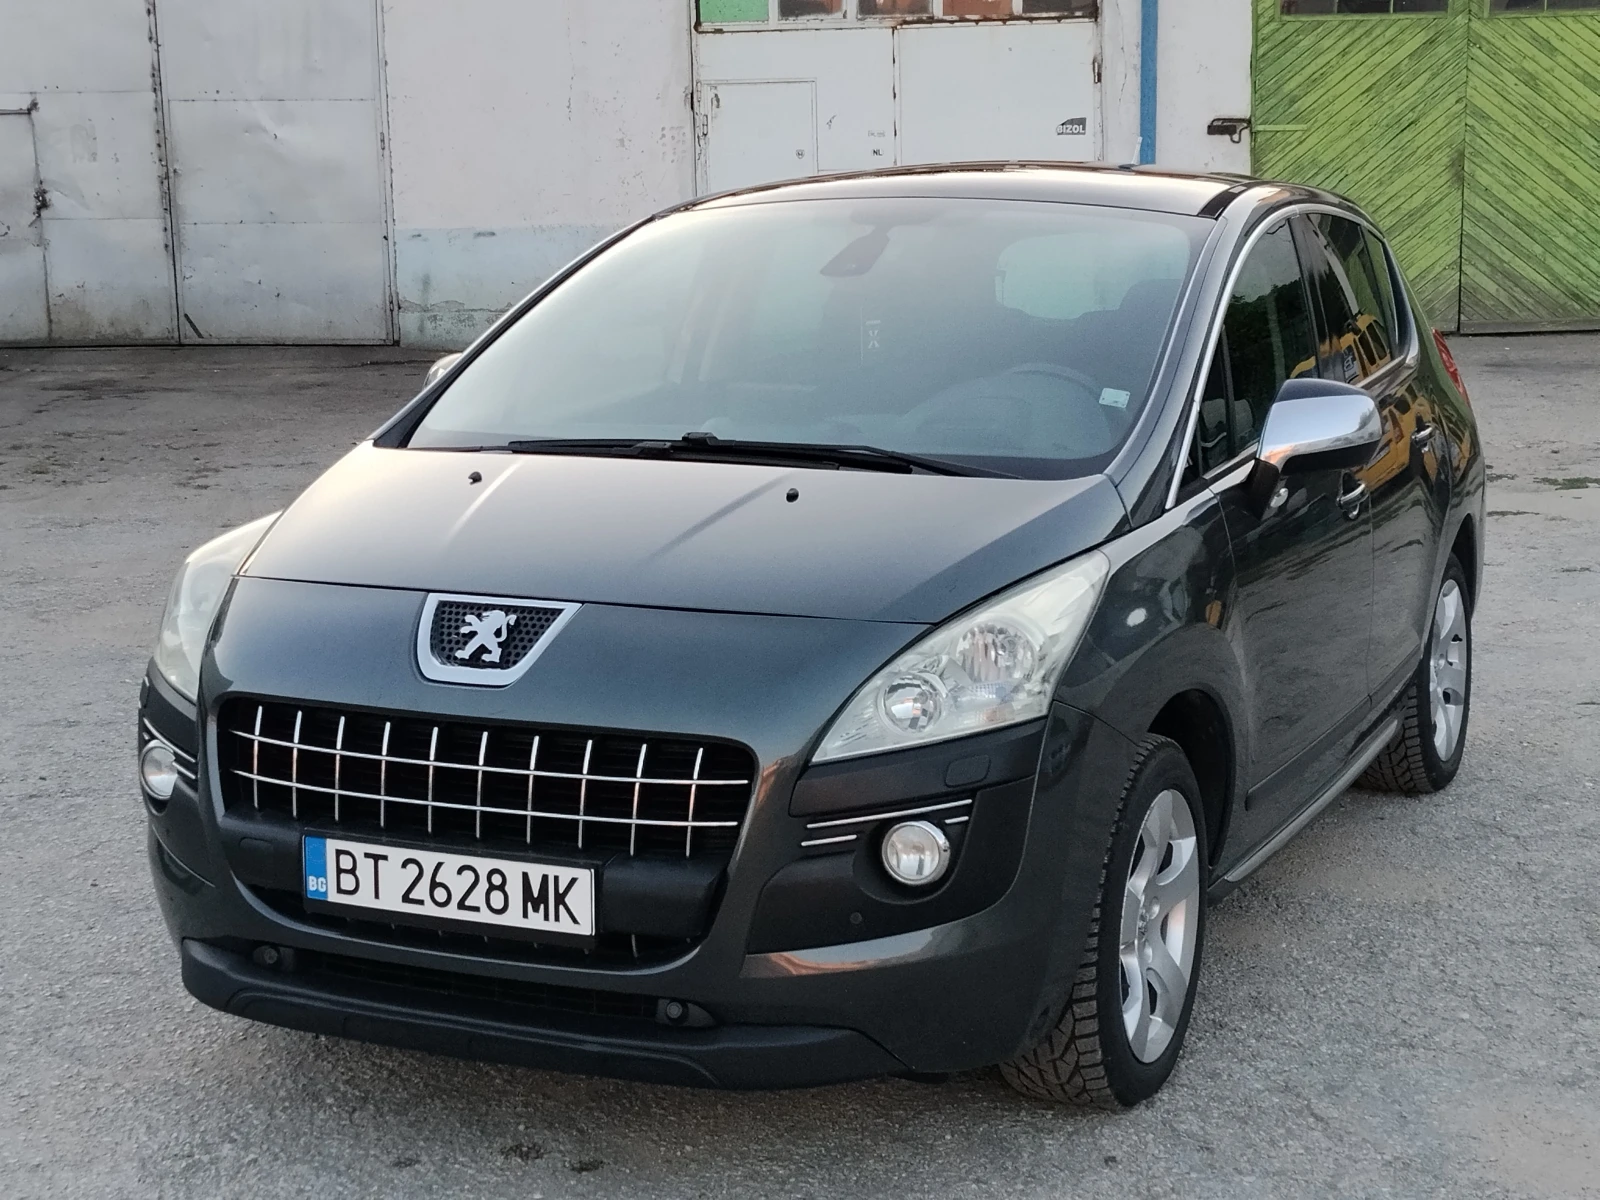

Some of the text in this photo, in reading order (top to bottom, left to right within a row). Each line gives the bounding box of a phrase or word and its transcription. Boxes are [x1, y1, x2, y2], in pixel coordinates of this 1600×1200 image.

[1057, 124, 1085, 133] BIZOL
[308, 875, 327, 893] BG
[334, 848, 581, 925] BT 2628 MK
